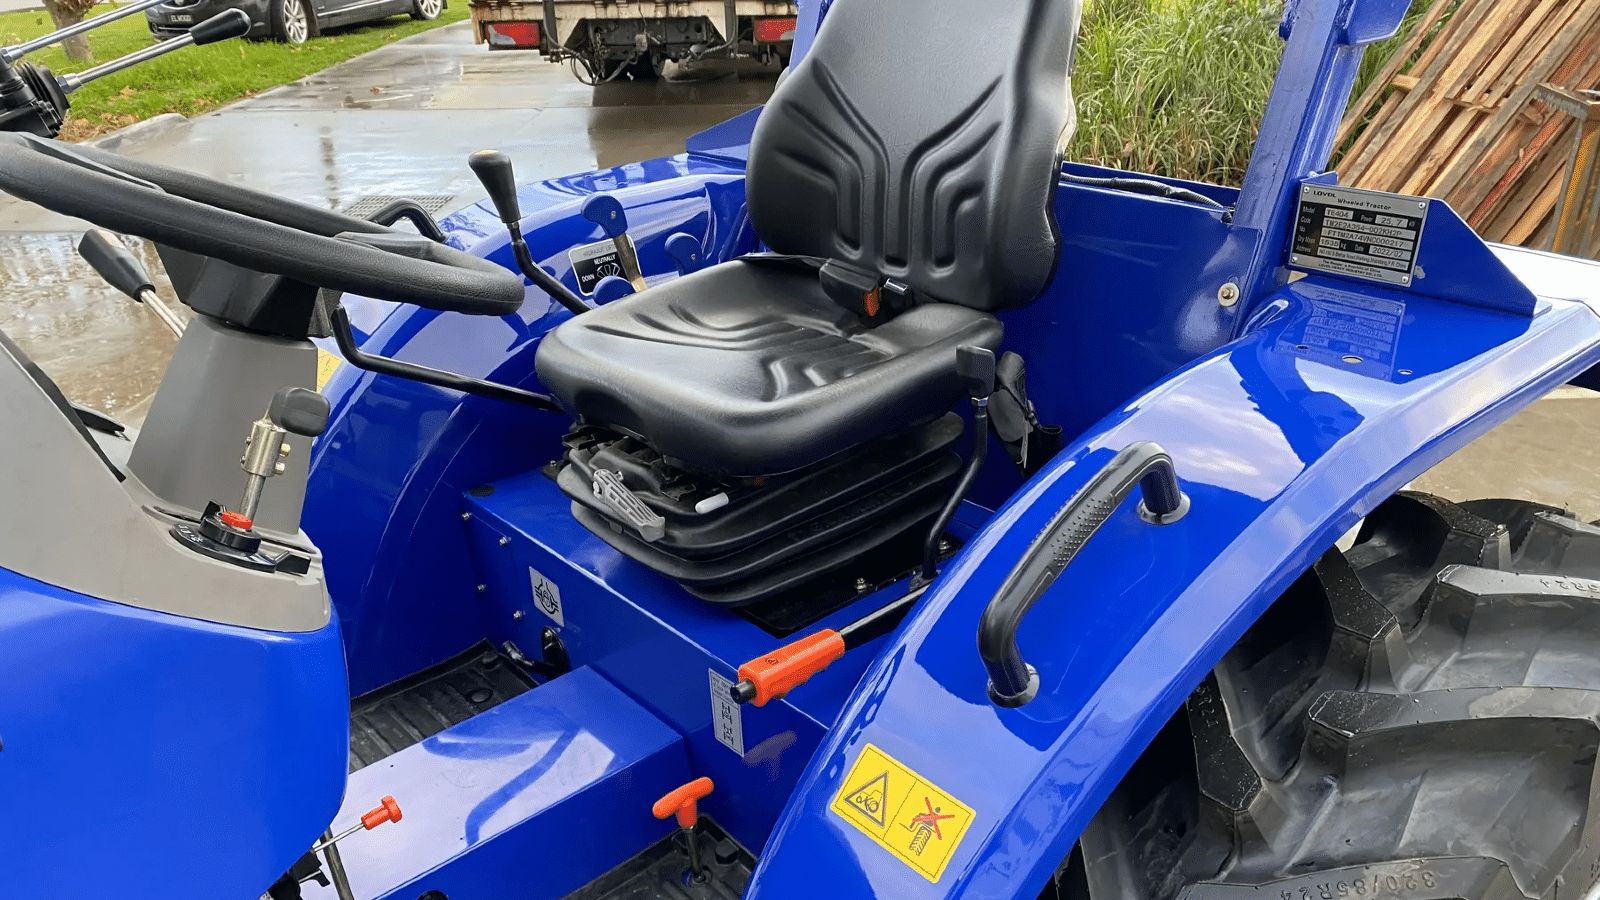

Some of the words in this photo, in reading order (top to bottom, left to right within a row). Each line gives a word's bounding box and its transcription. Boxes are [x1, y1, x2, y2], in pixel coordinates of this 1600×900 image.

[1313, 190, 1337, 198] LOVOL
[1337, 198, 1363, 206] Wheeled
[1365, 202, 1391, 210] Tractor
[1302, 205, 1315, 213] Model
[1326, 208, 1349, 218] TE404
[1372, 246, 1404, 258] 2022/02
[582, 274, 595, 283] DOWN
[1281, 871, 1435, 900] 320/85R24
